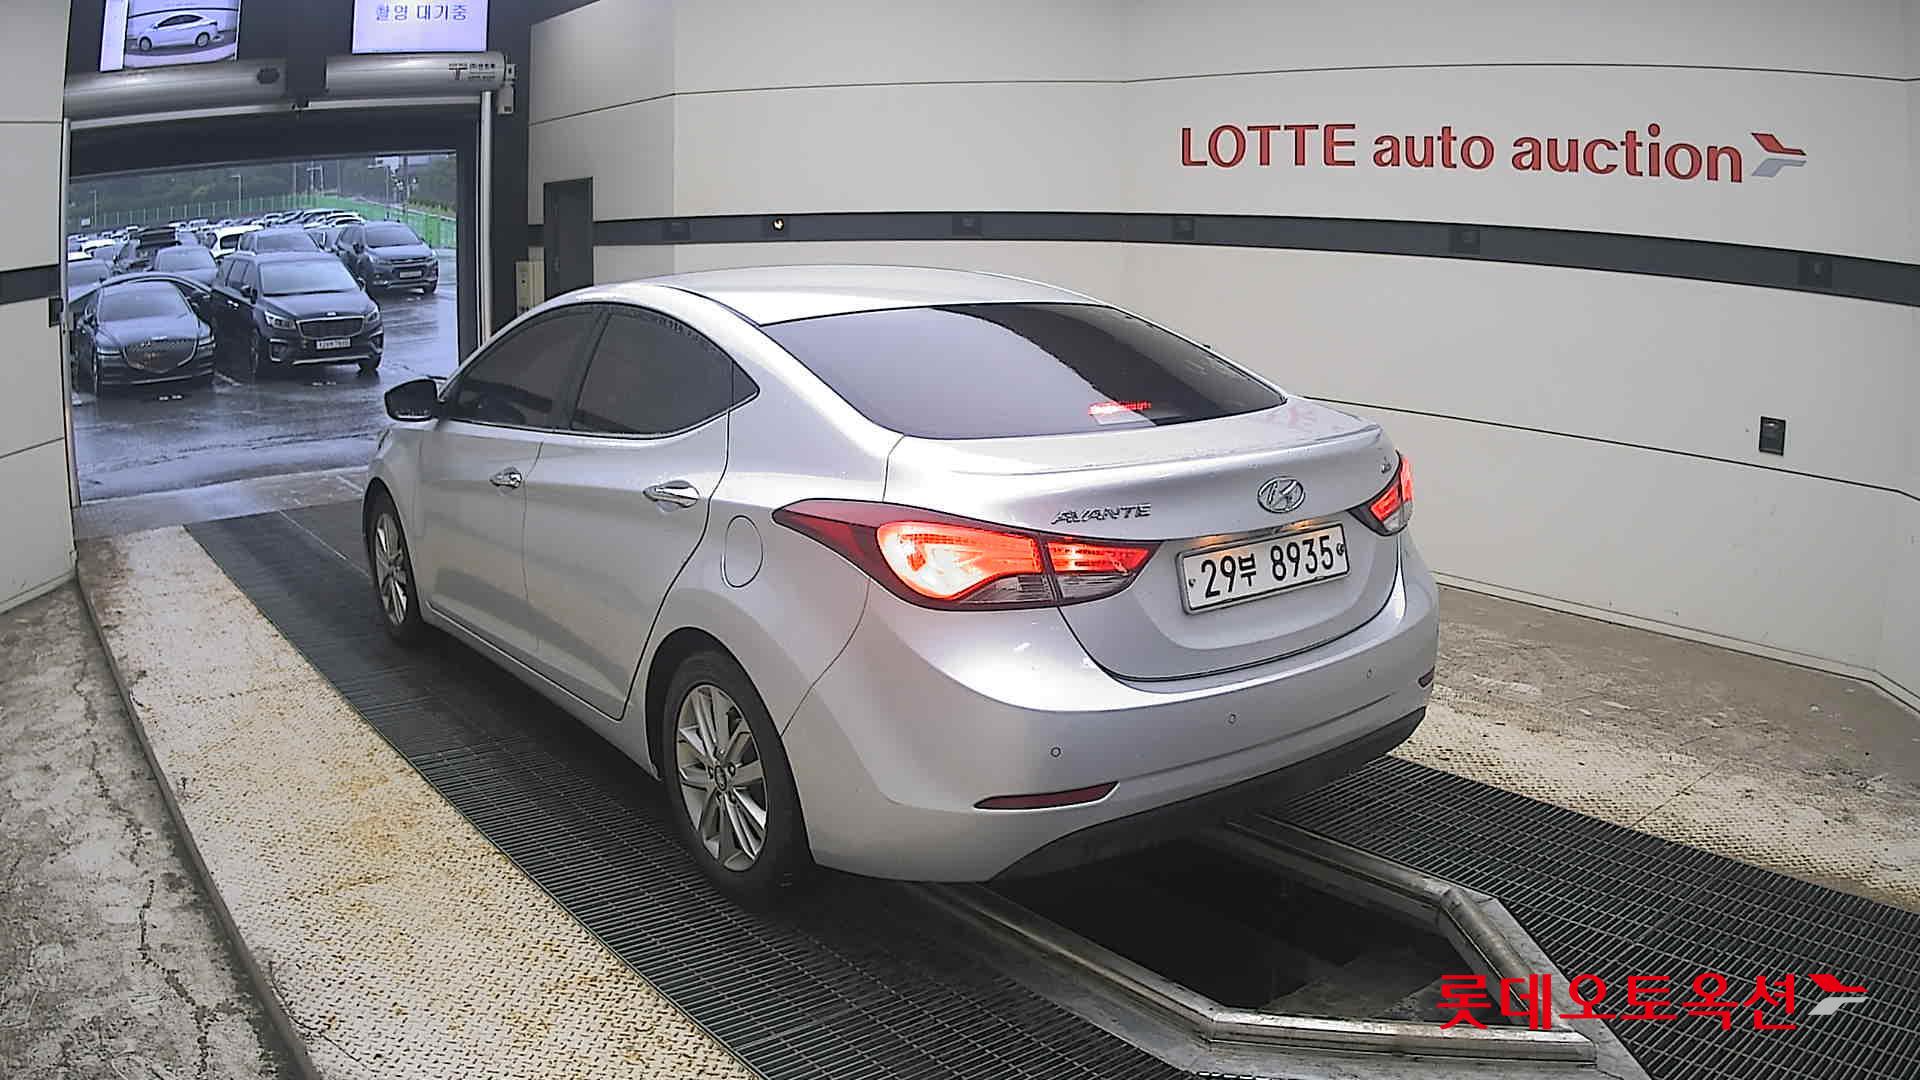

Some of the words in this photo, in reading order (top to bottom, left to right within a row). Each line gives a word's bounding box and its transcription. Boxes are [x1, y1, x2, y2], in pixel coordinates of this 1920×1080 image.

[416, 4, 467, 20] 대기중
[1181, 124, 1356, 167] LOTTE
[1373, 127, 1494, 170] auto
[1511, 123, 1743, 183] auction
[1052, 503, 1152, 525] AVANTE
[1200, 553, 1257, 599] 29부
[1270, 535, 1334, 581] 8935
